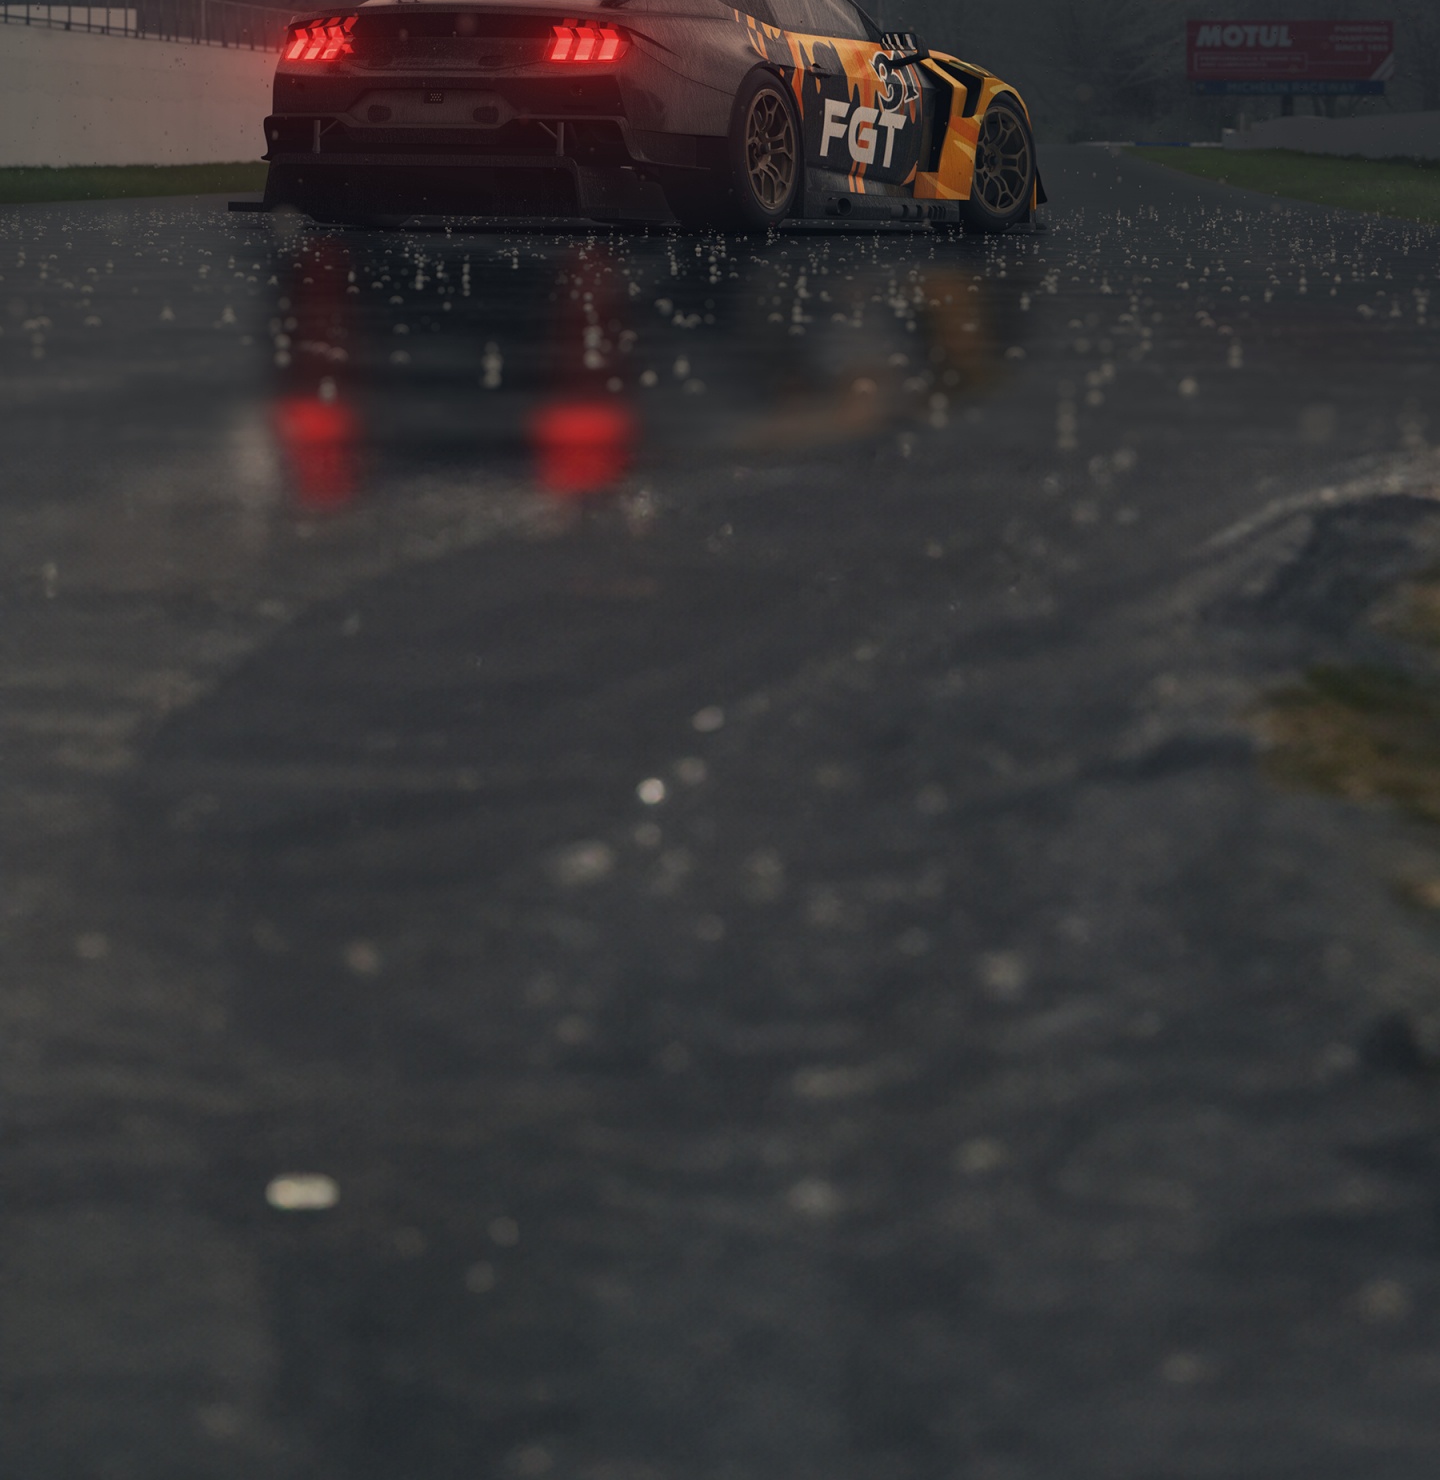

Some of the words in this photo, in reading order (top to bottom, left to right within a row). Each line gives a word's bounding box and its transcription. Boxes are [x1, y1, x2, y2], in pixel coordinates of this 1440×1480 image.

[1195, 25, 1293, 48] MOTUL
[1226, 81, 1289, 93] MICHELIN
[1291, 81, 1356, 93] RACEWAY
[819, 98, 907, 168] FGT
